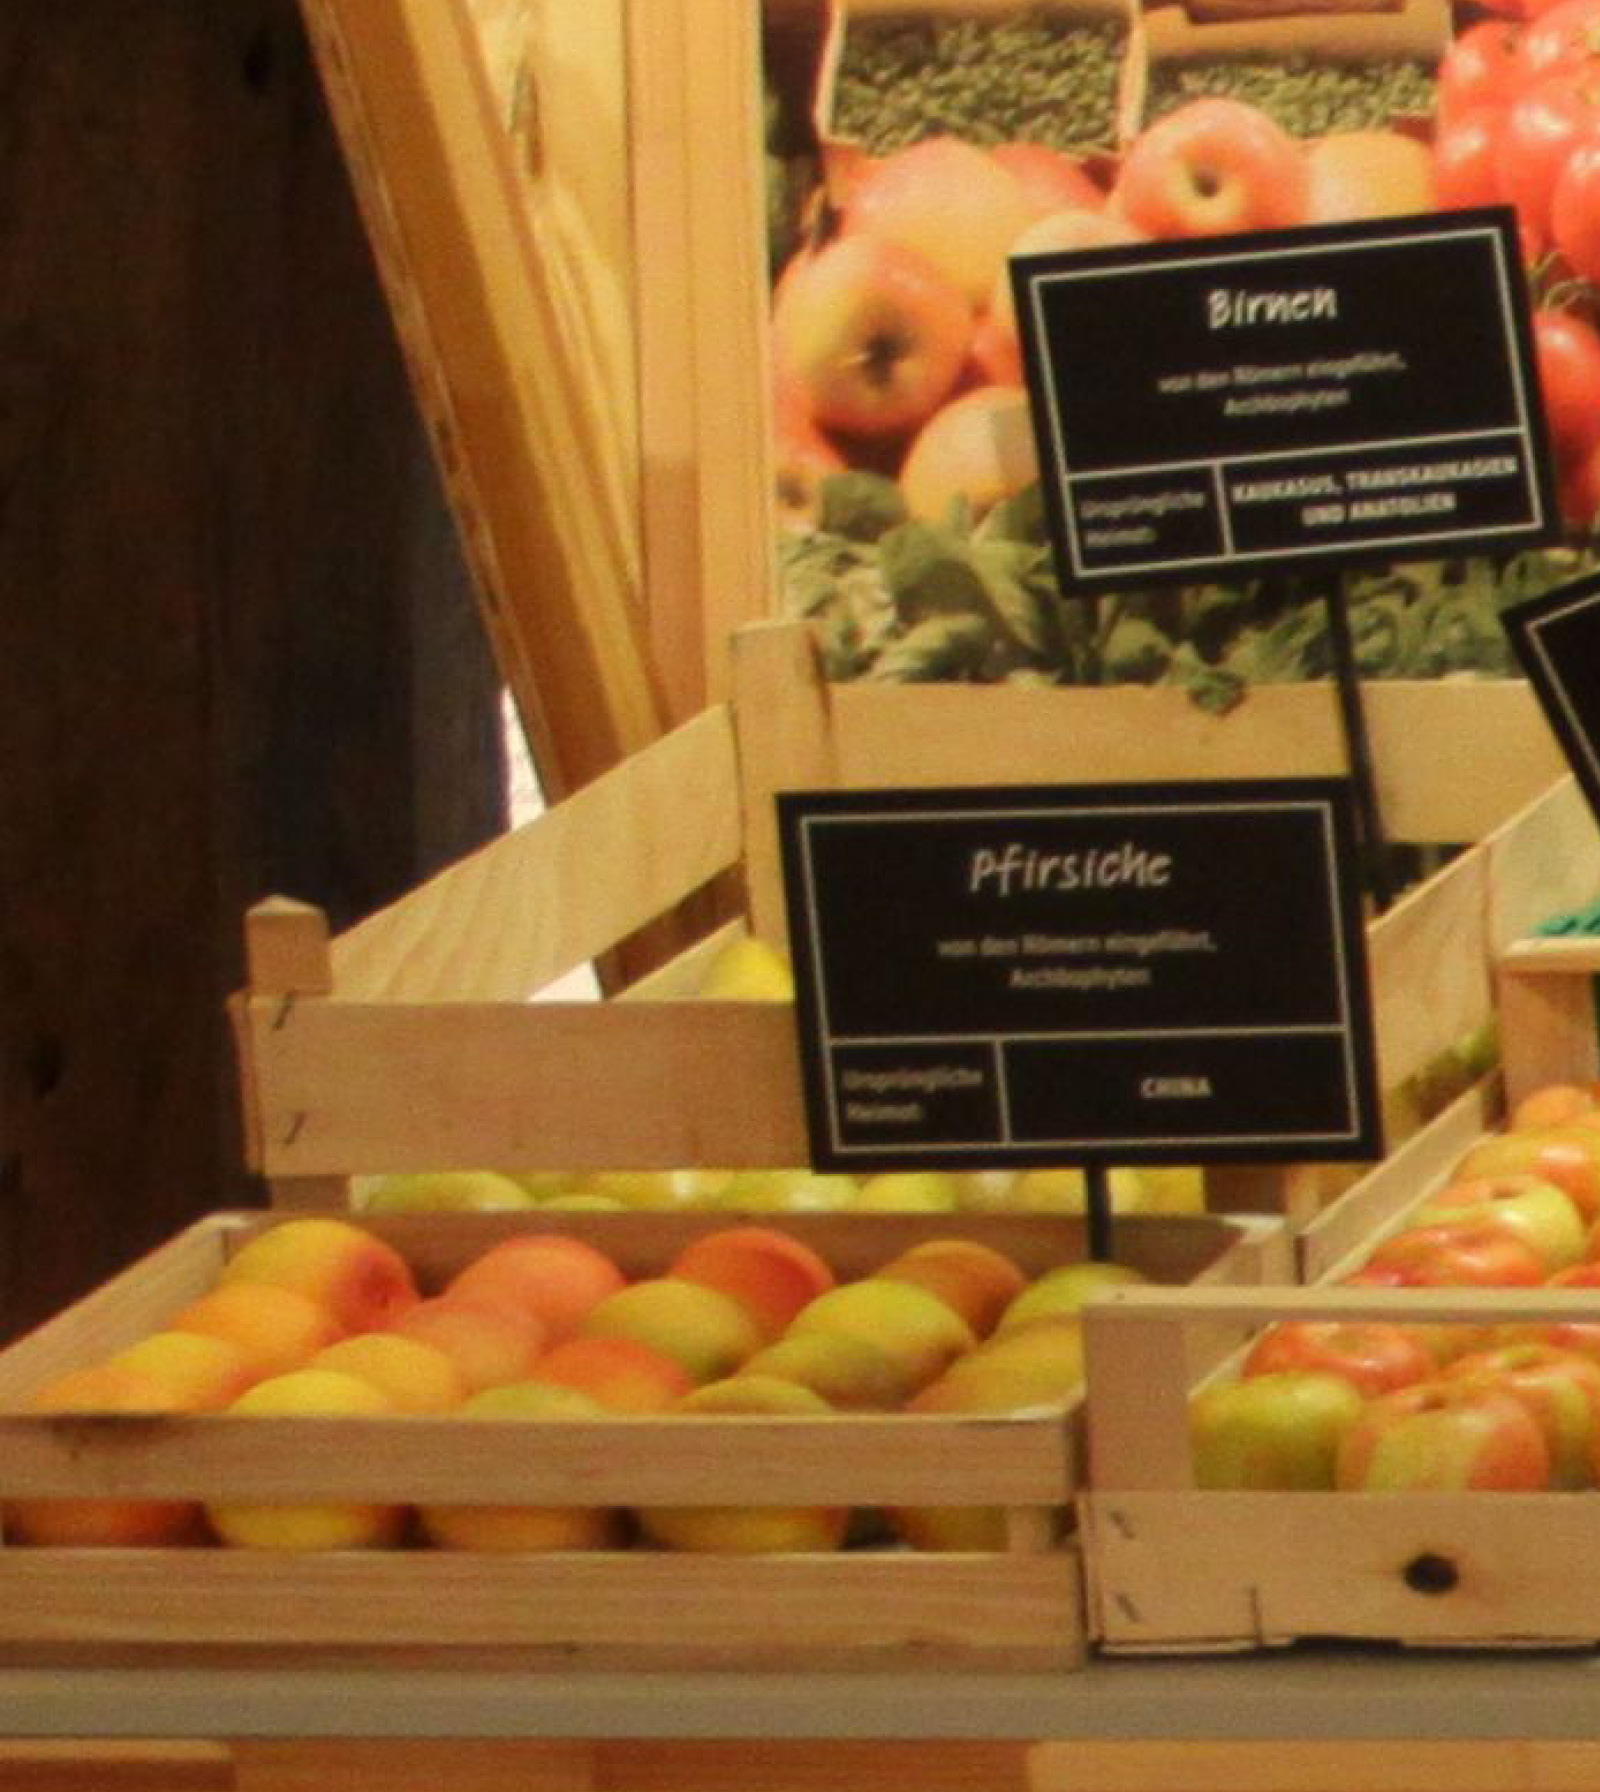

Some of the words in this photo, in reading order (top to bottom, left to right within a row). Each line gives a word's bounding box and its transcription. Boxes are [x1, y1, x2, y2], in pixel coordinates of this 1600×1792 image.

[1207, 287, 1338, 330] Birnen
[1232, 474, 1342, 504] KAUKASUS,
[1346, 456, 1519, 490] TRANSKAUKASIEN
[1303, 504, 1346, 527] UND
[1350, 492, 1456, 522] ANATOLIEN
[968, 840, 1174, 897] Pfirsiche
[1140, 1076, 1212, 1099] CHINA
